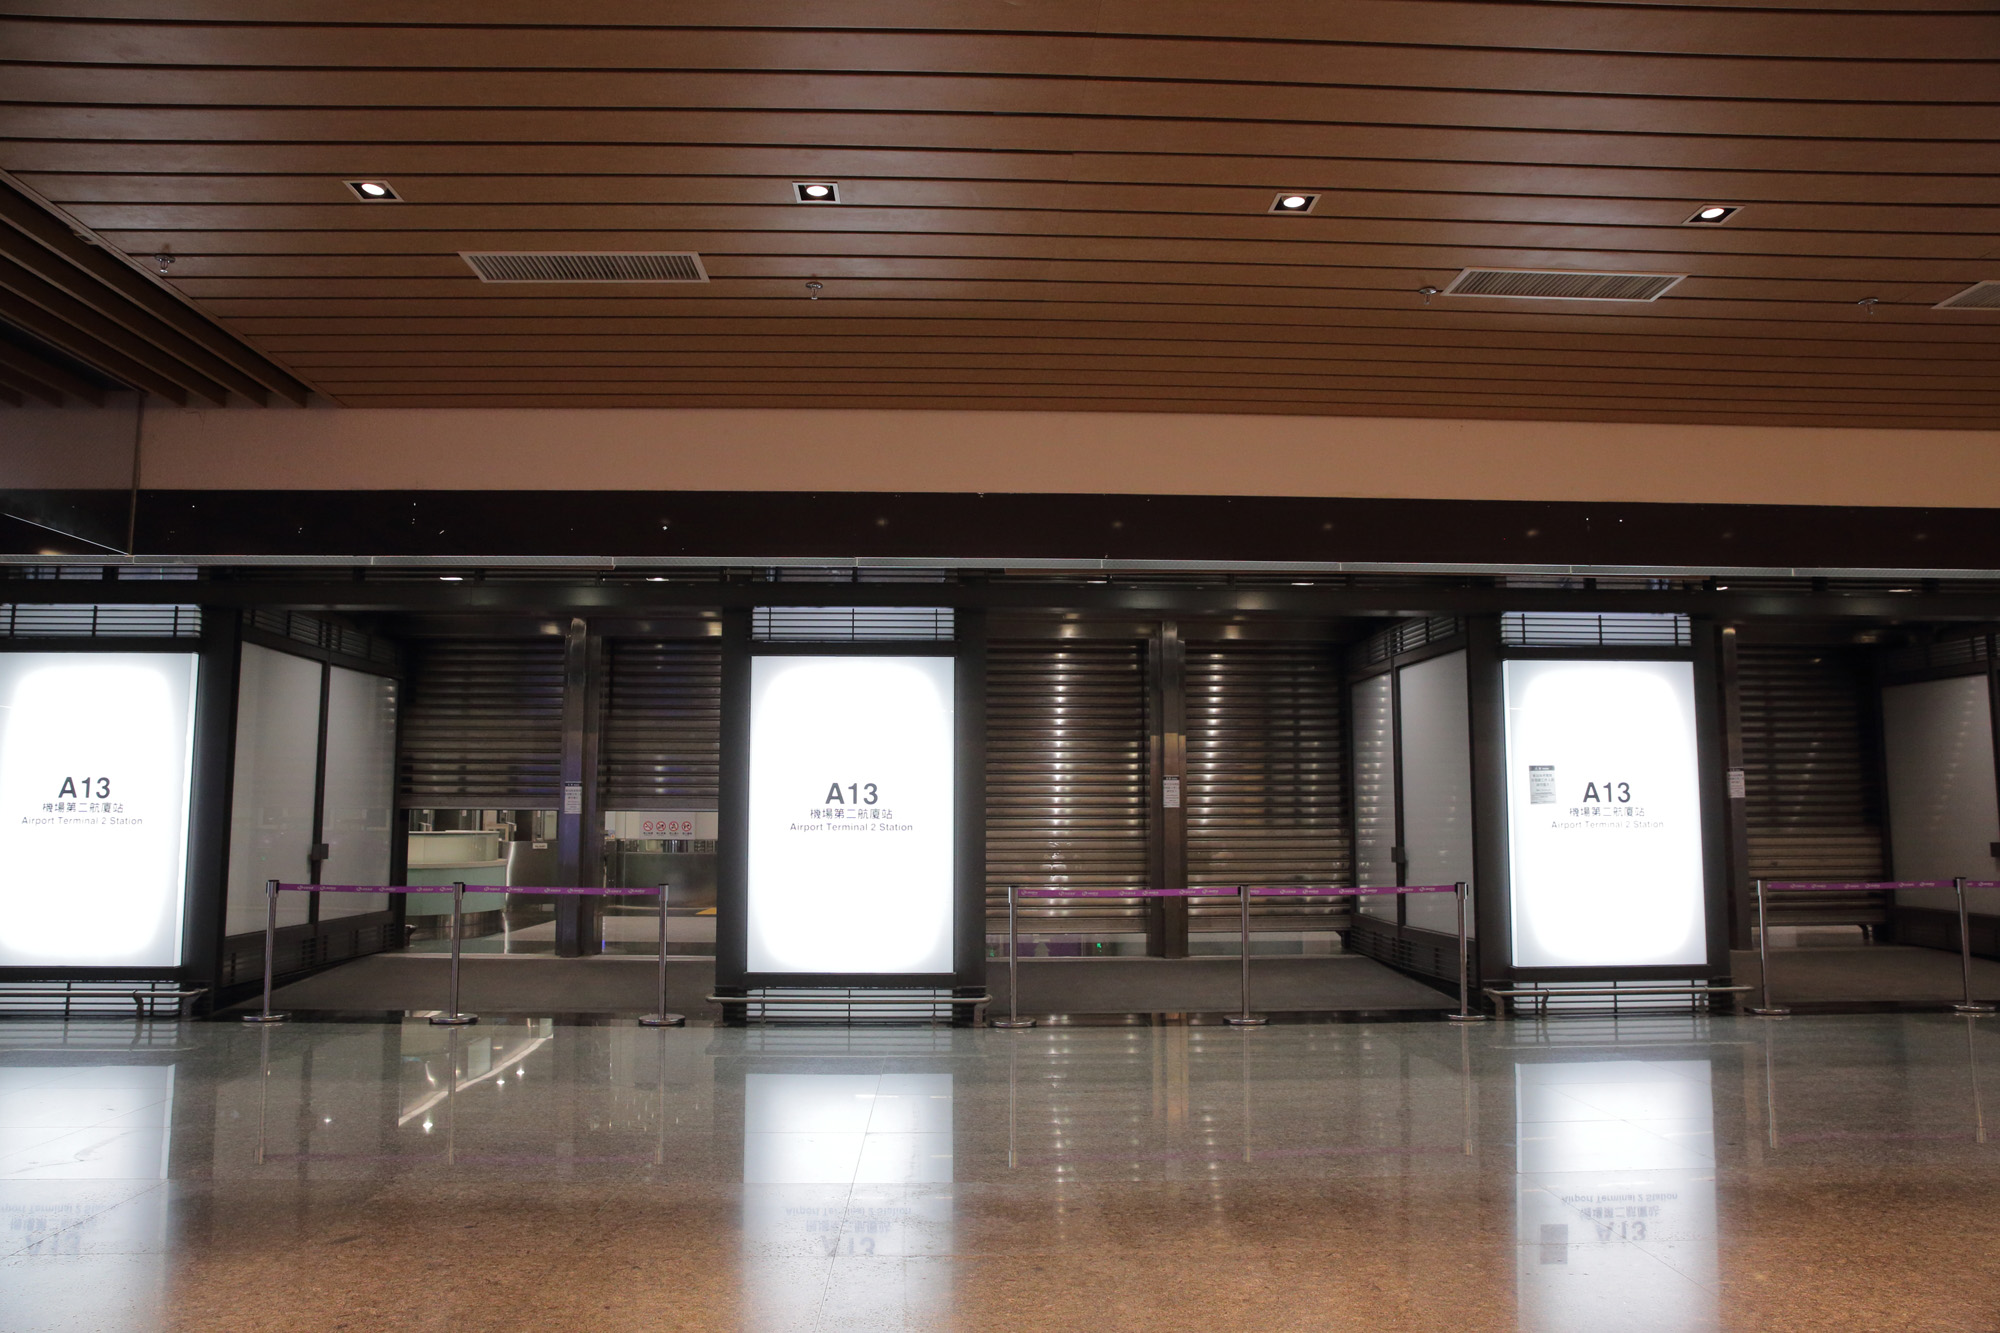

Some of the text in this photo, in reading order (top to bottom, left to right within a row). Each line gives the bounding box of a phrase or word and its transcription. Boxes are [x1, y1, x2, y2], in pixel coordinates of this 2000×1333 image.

[58, 776, 111, 799] A13
[825, 782, 879, 805] A13
[1582, 780, 1632, 804] A13
[42, 801, 124, 813] 機場第二航廈站
[809, 807, 893, 820] 機場第二航廈站
[21, 816, 143, 826] Airport Terminal 2 Station
[1551, 820, 1664, 830] Airport Terminal 2 Station
[790, 822, 913, 833] Airport Terminal 2 Station
